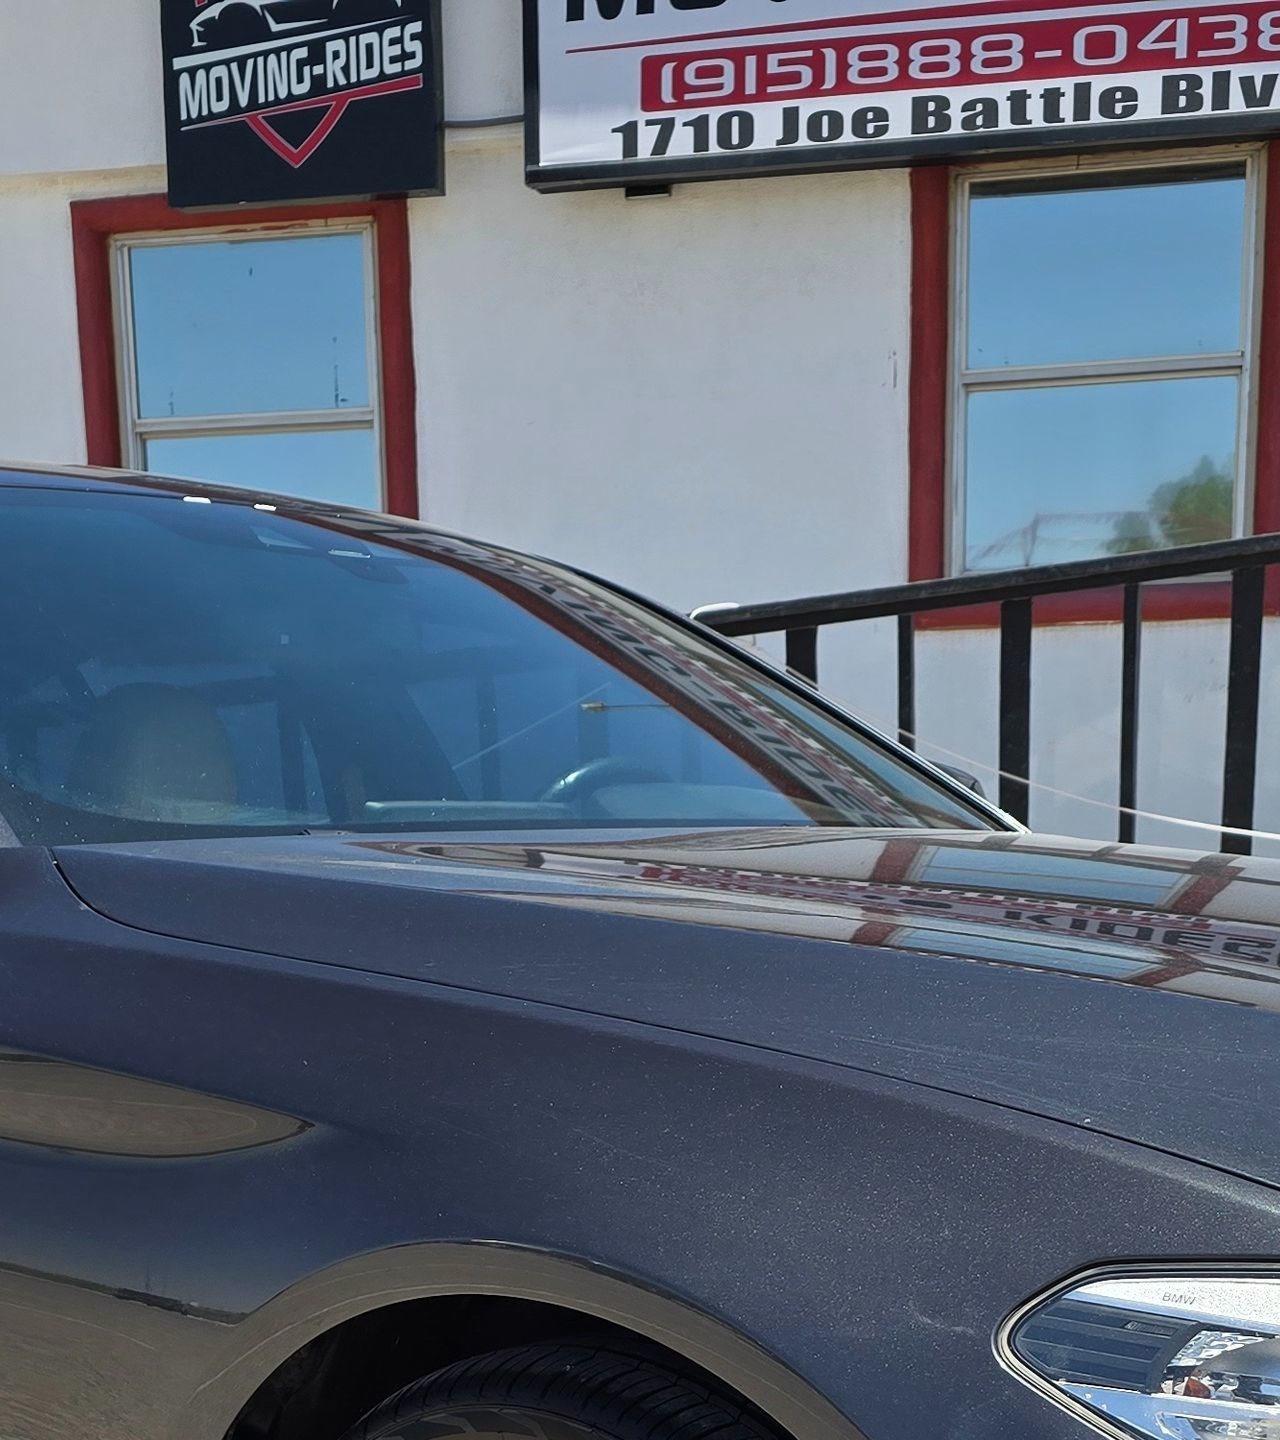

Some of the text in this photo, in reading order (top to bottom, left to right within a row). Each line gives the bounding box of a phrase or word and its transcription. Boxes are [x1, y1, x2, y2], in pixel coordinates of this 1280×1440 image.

[179, 21, 423, 121] MOVING-RIDES
[611, 110, 754, 158] 1710
[776, 106, 888, 146] Joe
[911, 82, 1138, 134] Battle
[1162, 1291, 1196, 1305] BMW
